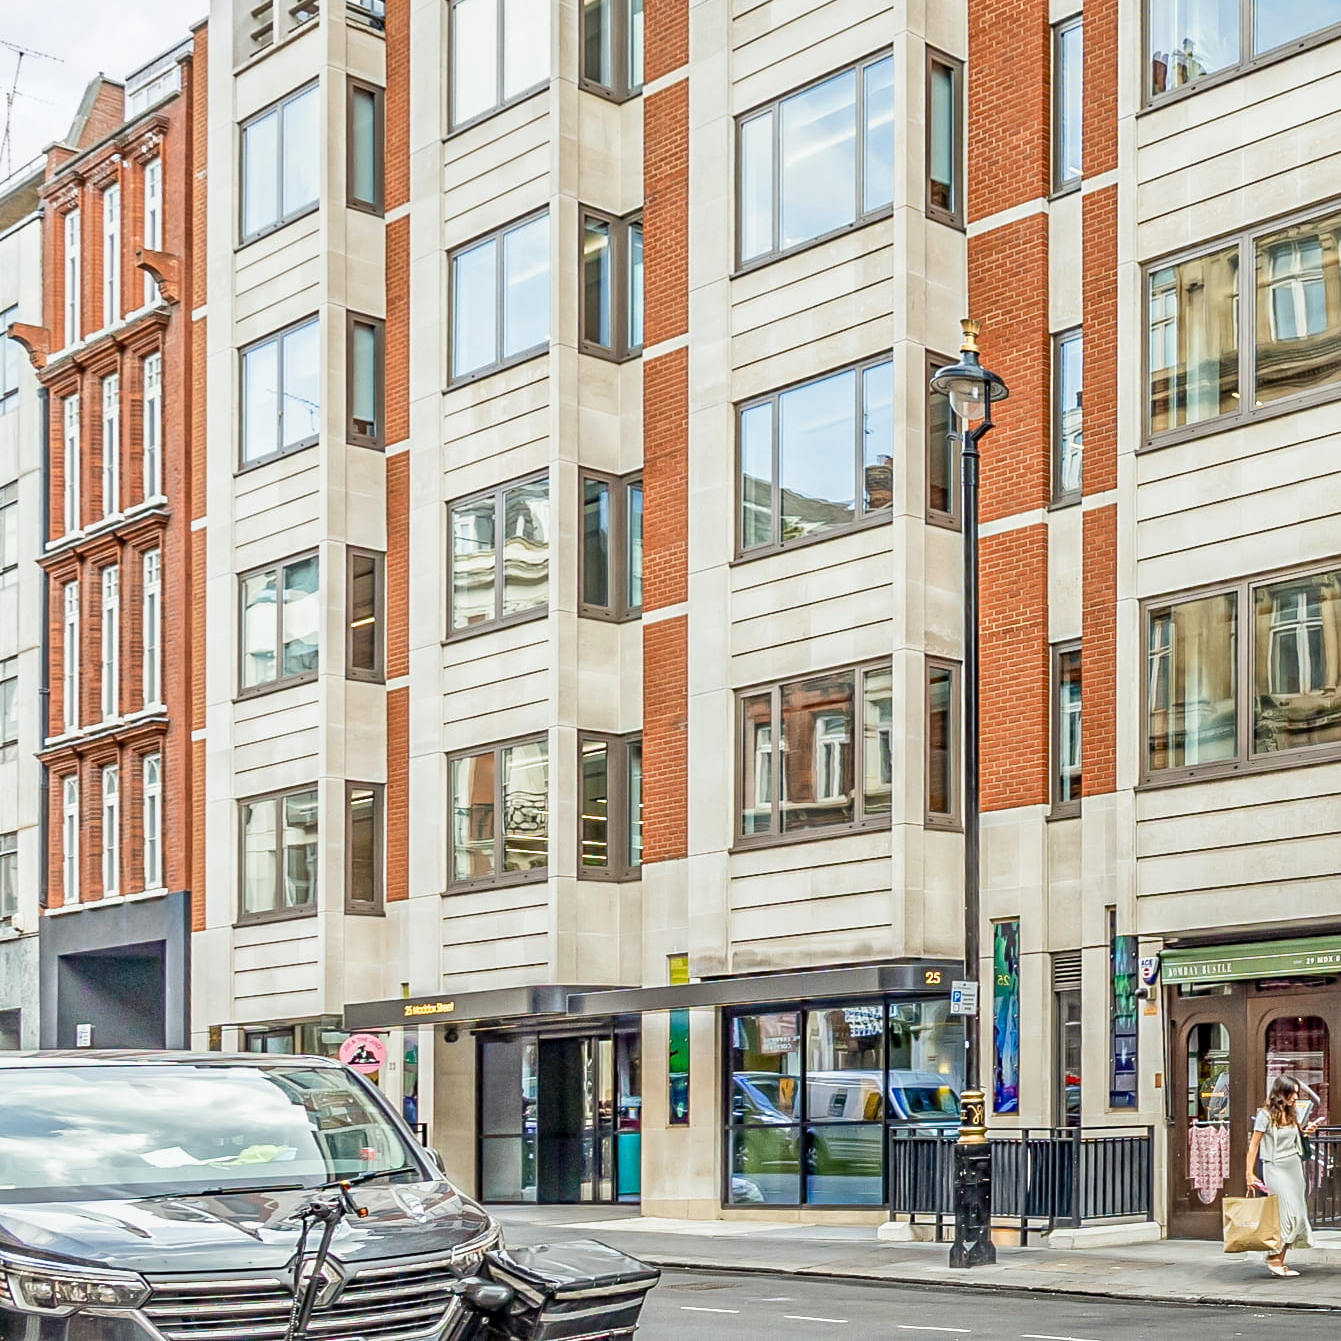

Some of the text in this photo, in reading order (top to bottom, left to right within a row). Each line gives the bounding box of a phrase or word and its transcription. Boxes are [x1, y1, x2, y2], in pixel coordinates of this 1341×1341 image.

[1168, 963, 1231, 977] BOMBAY BUSTLE
[925, 972, 940, 984] 25
